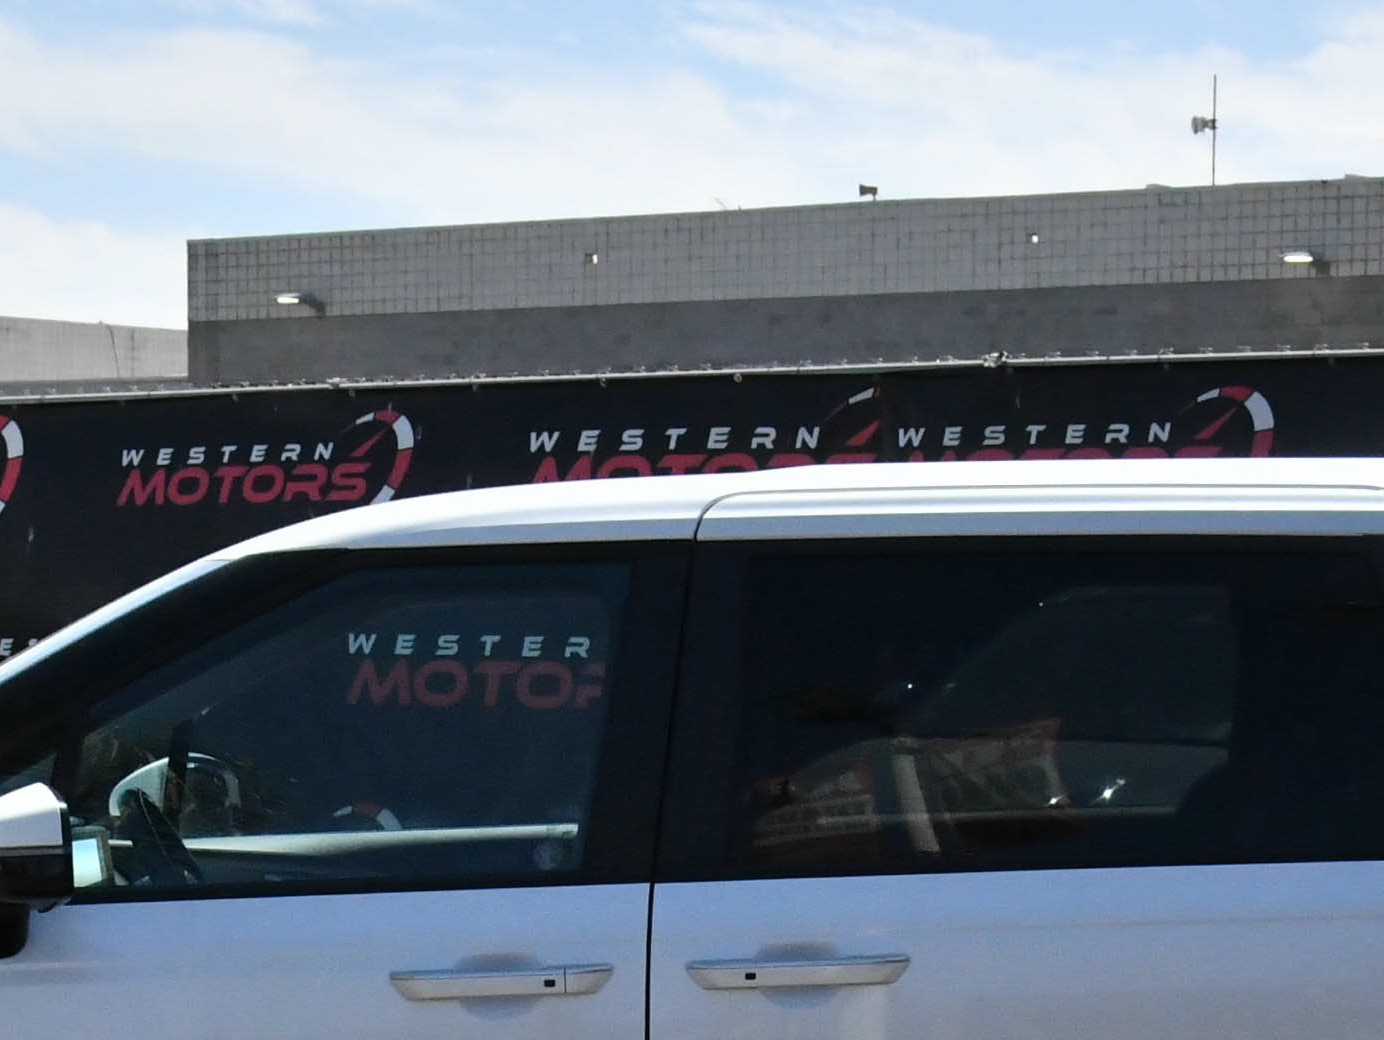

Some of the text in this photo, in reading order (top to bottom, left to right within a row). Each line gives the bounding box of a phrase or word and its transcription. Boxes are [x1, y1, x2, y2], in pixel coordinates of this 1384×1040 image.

[529, 426, 821, 453] WESTERN
[898, 422, 1172, 449] WESTERN
[121, 442, 334, 467] WESTERN
[117, 462, 372, 507] MOTORS
